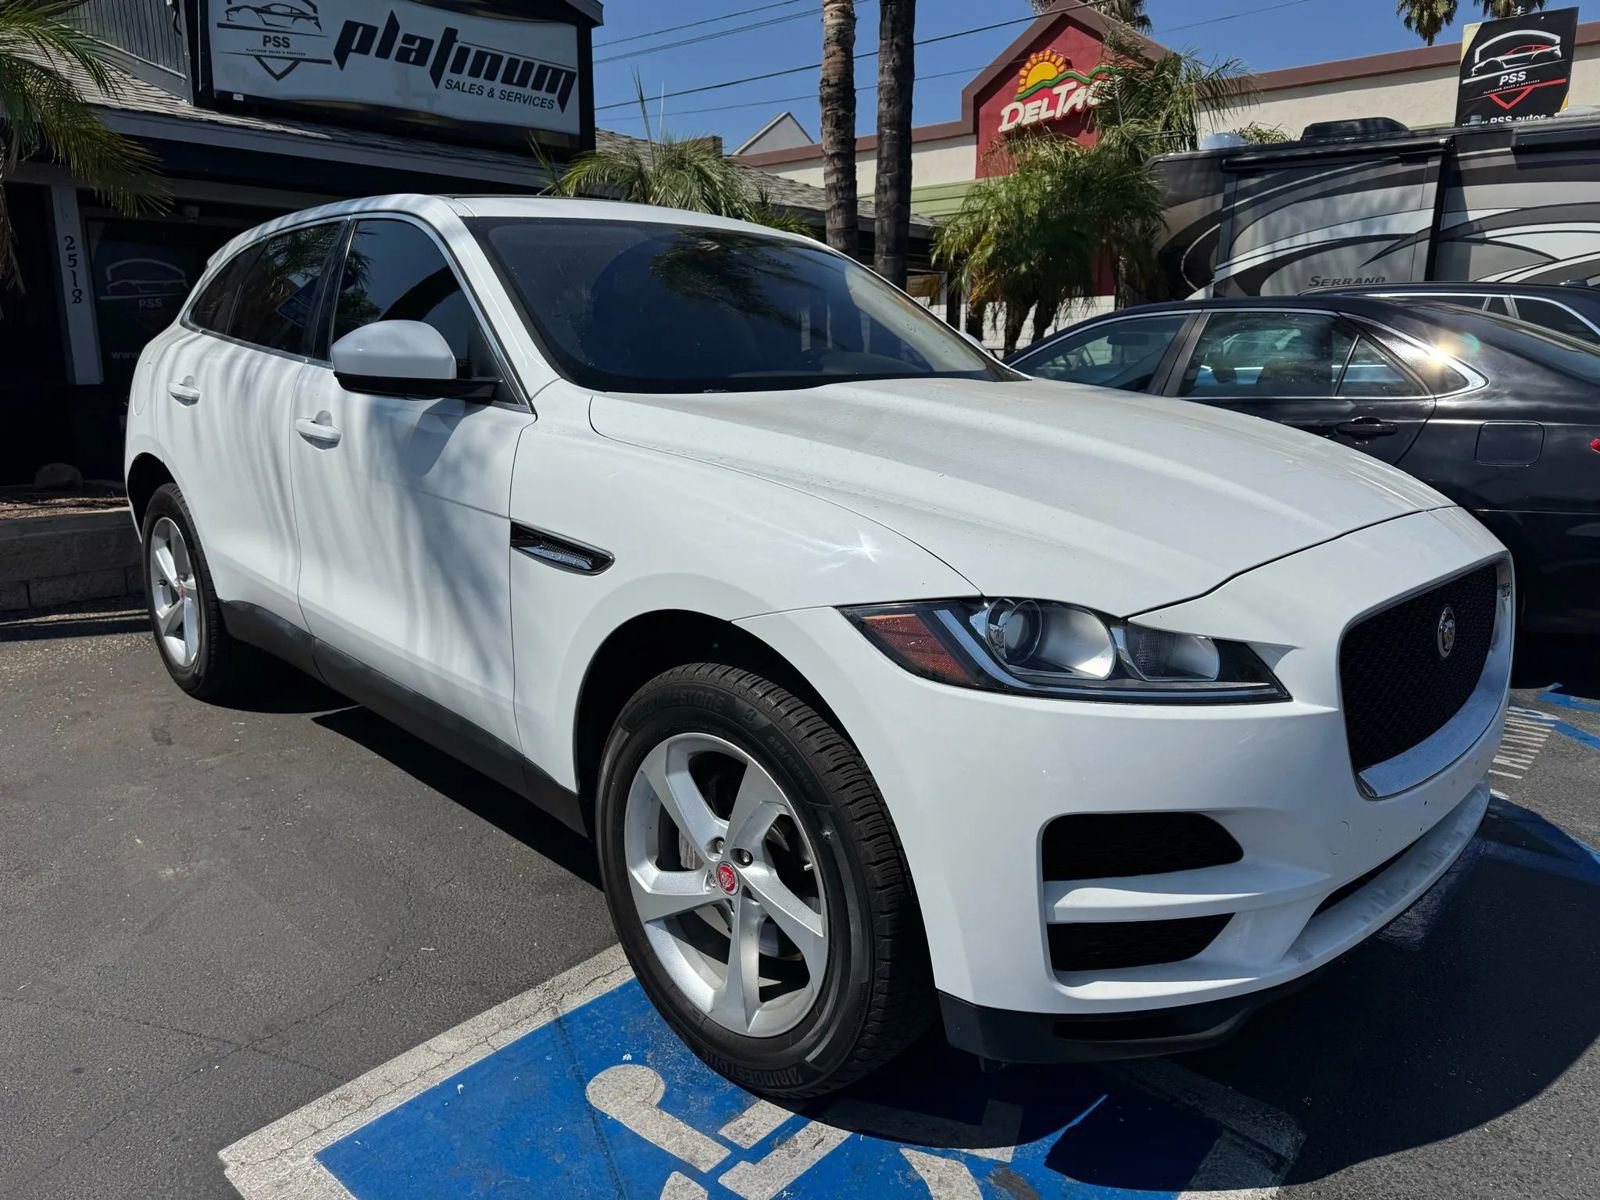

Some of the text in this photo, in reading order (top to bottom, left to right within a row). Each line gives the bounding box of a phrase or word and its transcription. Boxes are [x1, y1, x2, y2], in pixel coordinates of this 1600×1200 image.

[262, 34, 291, 49] PSS
[333, 9, 577, 114] platinum
[444, 78, 555, 110] SALES & SERVICES
[1499, 71, 1527, 86] PSS
[998, 96, 1056, 133] DEL
[63, 235, 83, 305] 2518
[138, 298, 163, 309] PSS
